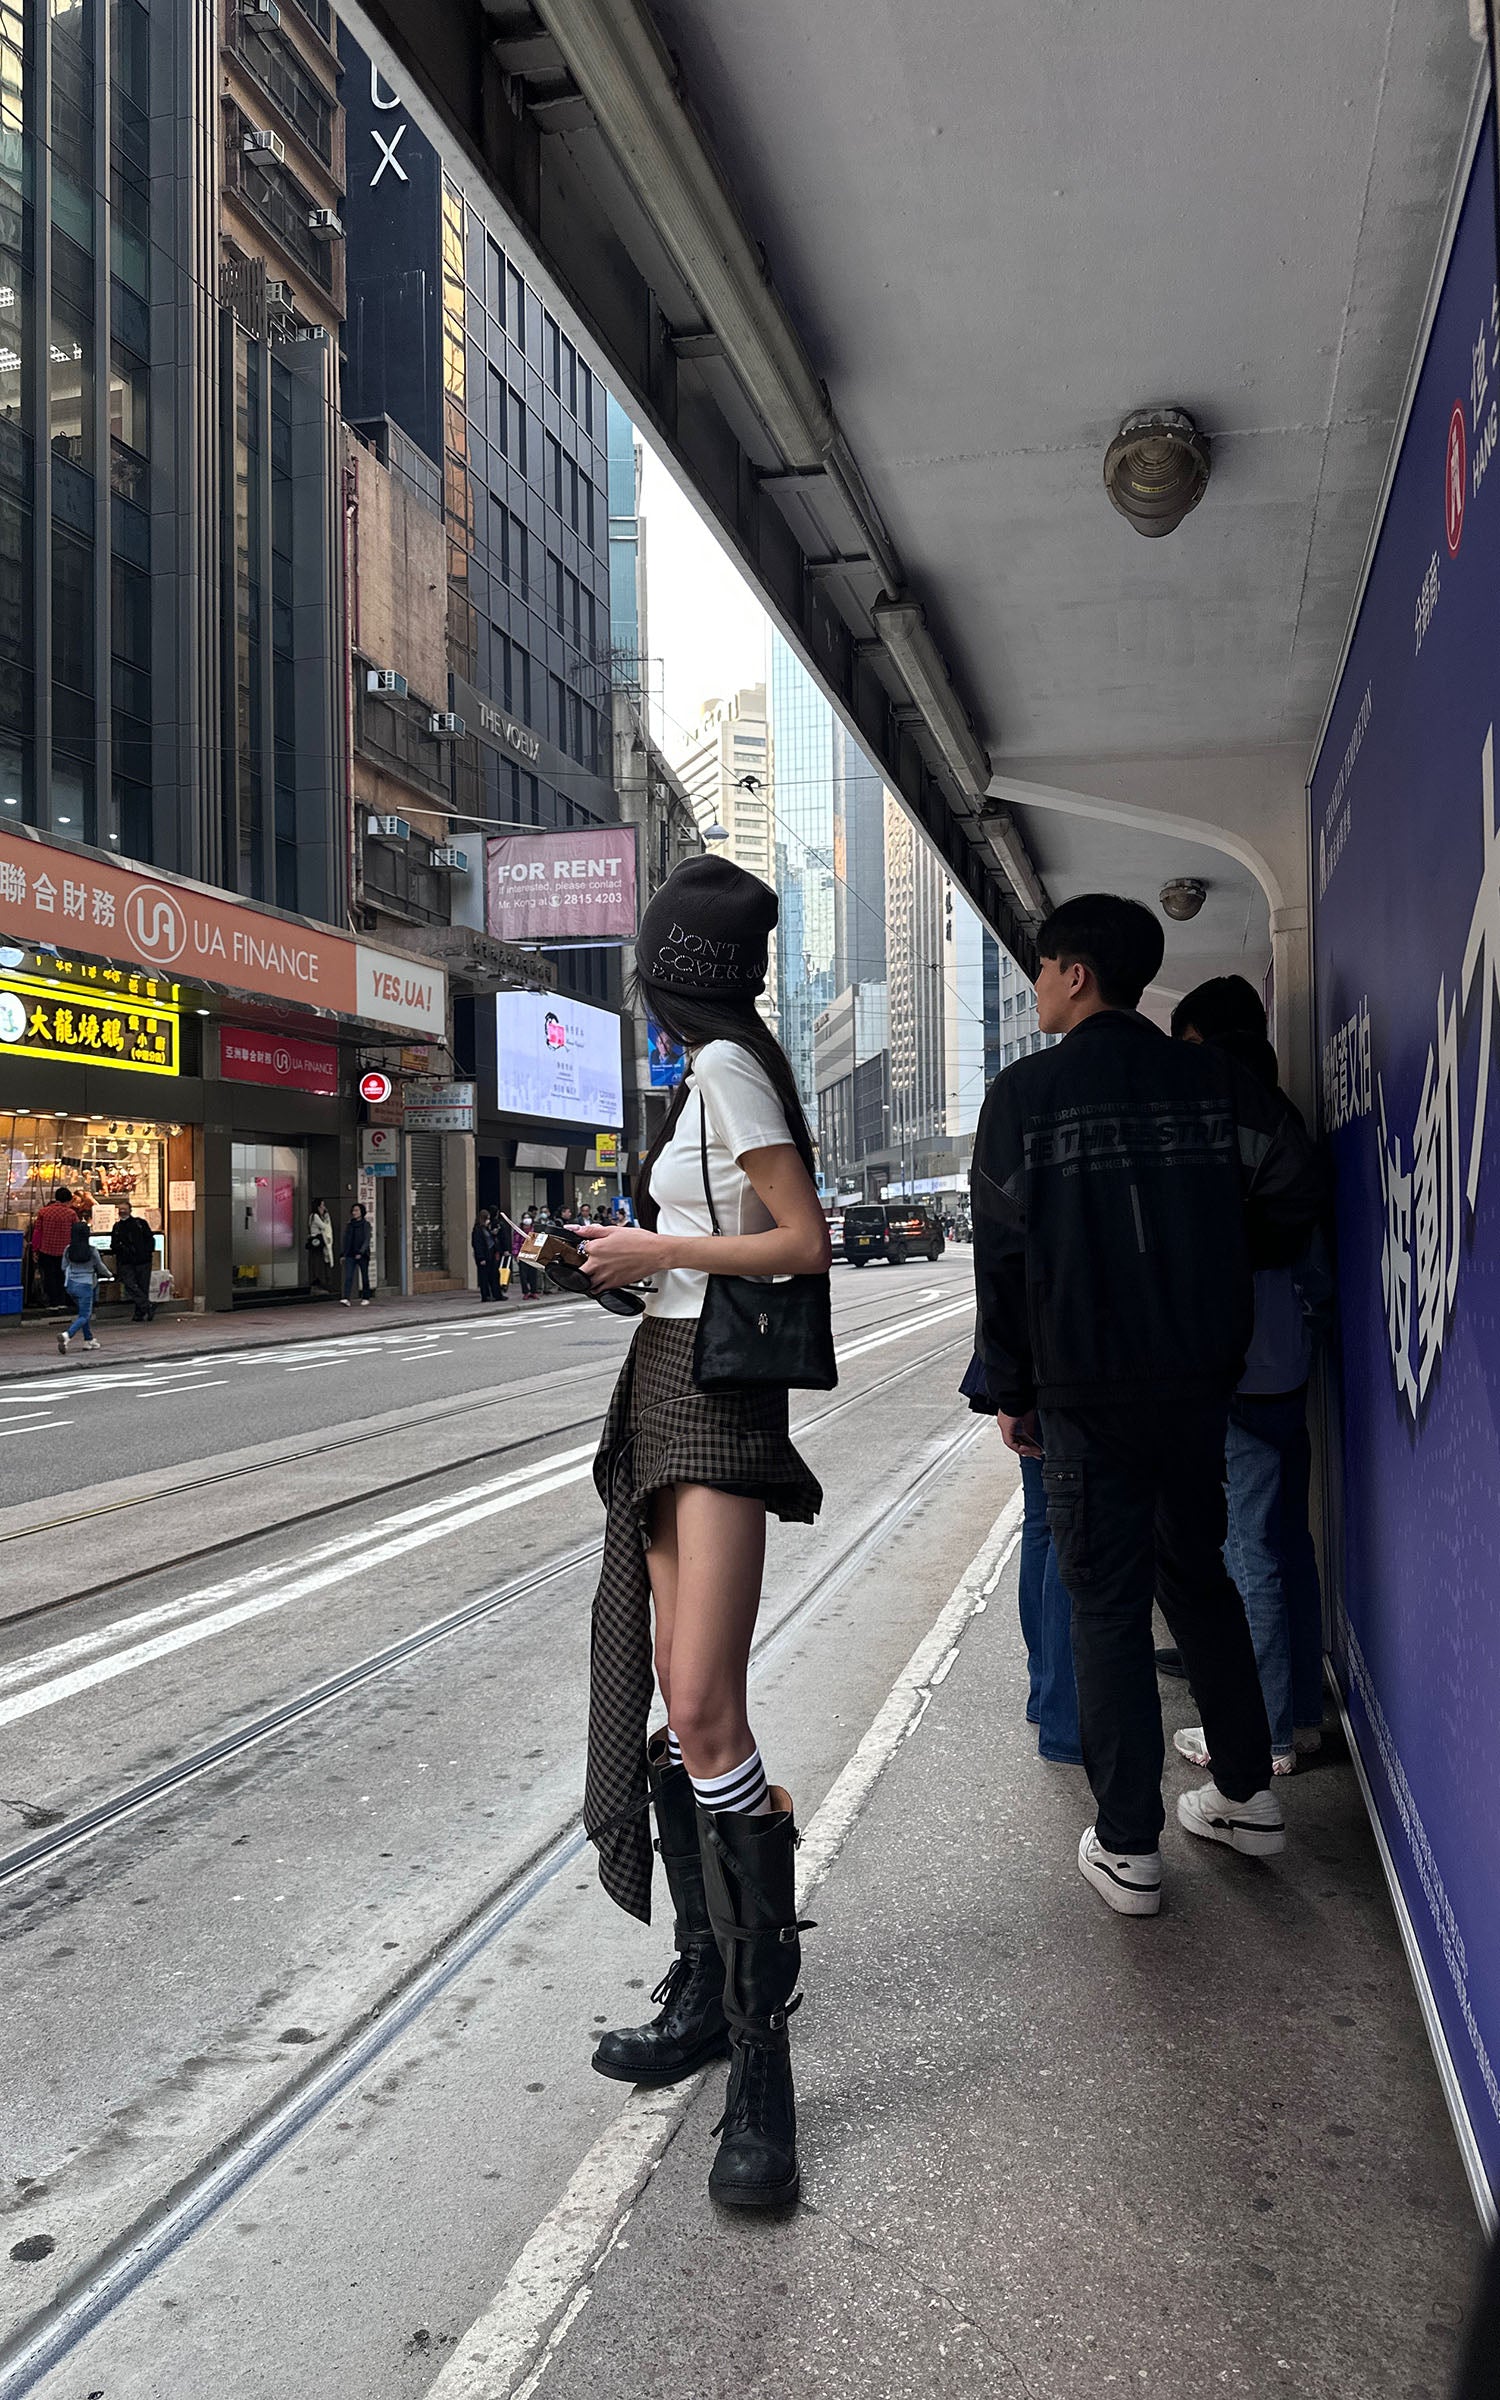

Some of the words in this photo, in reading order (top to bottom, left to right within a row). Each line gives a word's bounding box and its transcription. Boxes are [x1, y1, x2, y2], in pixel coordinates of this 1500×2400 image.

[1473, 400, 1498, 499] HANG
[479, 702, 501, 737] THE
[498, 862, 546, 884] FOR
[553, 858, 622, 879] RENT
[506, 882, 552, 895] interested,
[555, 881, 586, 892] please
[589, 879, 622, 889] contact
[0, 861, 117, 929] 聯合財務
[499, 901, 511, 909] Mr.
[514, 899, 536, 908] Kong
[538, 897, 547, 906] at
[564, 893, 592, 905] 2815
[594, 892, 622, 904] 4203
[194, 919, 226, 959] UA
[233, 931, 320, 984] FINANCE
[667, 922, 740, 960] DON'T
[658, 946, 739, 979] COVER
[28, 1004, 125, 1052] 大龍燒鵝
[292, 1058, 303, 1071] UA
[304, 1060, 334, 1076] FINANCE
